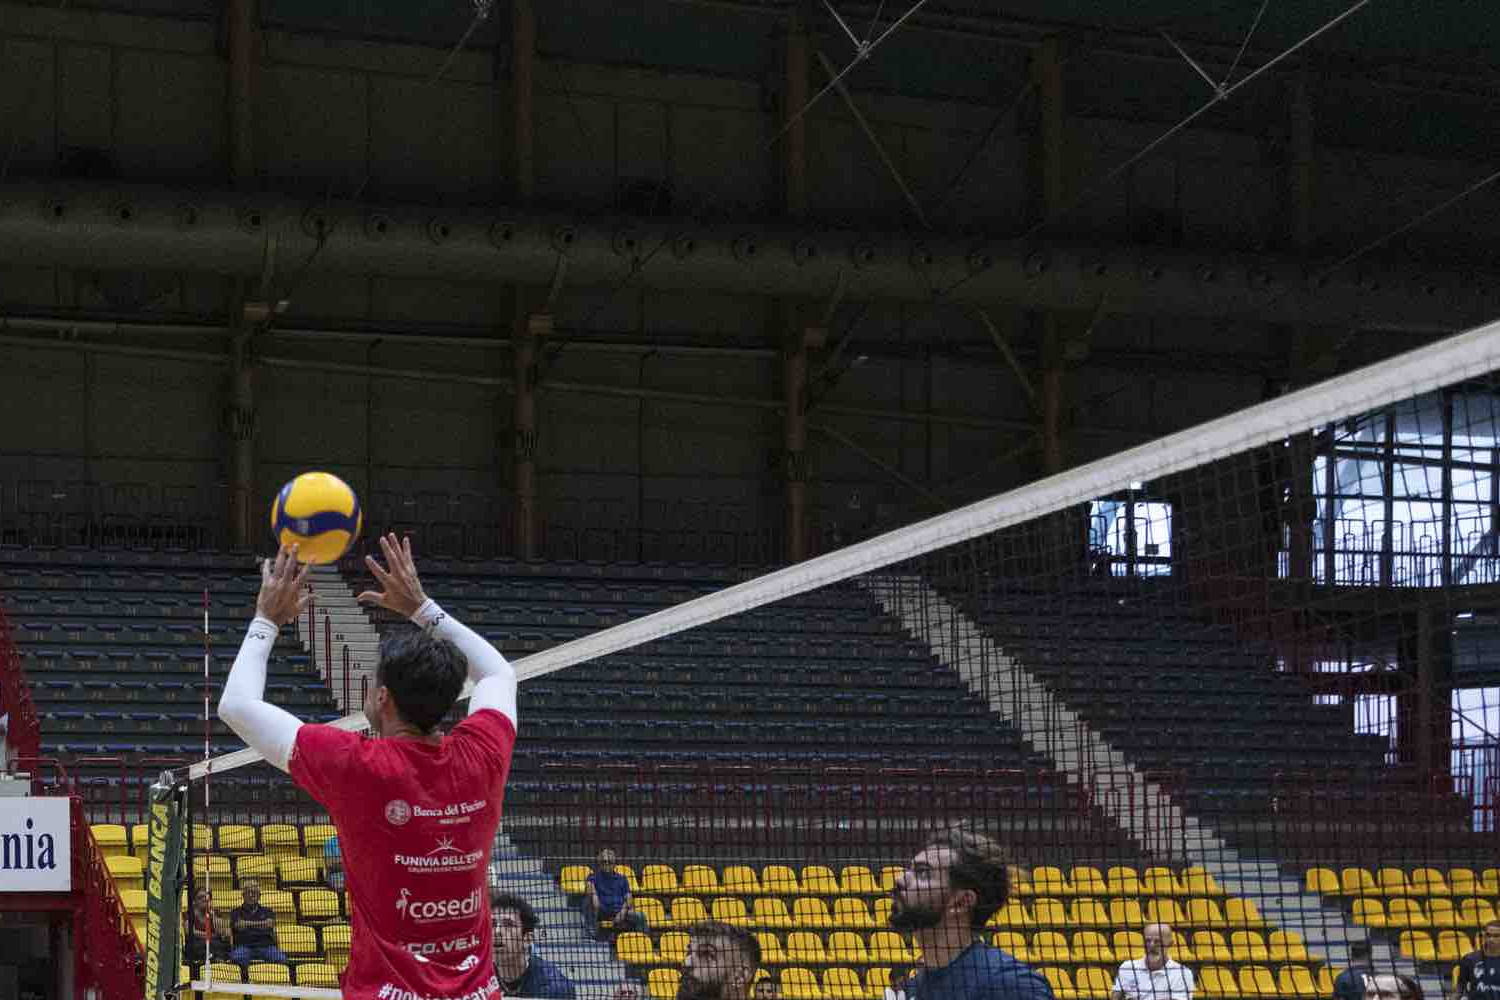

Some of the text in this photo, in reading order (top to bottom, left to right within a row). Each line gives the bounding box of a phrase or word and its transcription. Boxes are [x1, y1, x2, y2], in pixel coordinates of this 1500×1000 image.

[412, 805, 443, 817] Banca
[444, 804, 459, 816] del
[149, 802, 169, 900] BANCA
[394, 854, 440, 867] FUNIVIA
[409, 887, 482, 918] cosedil
